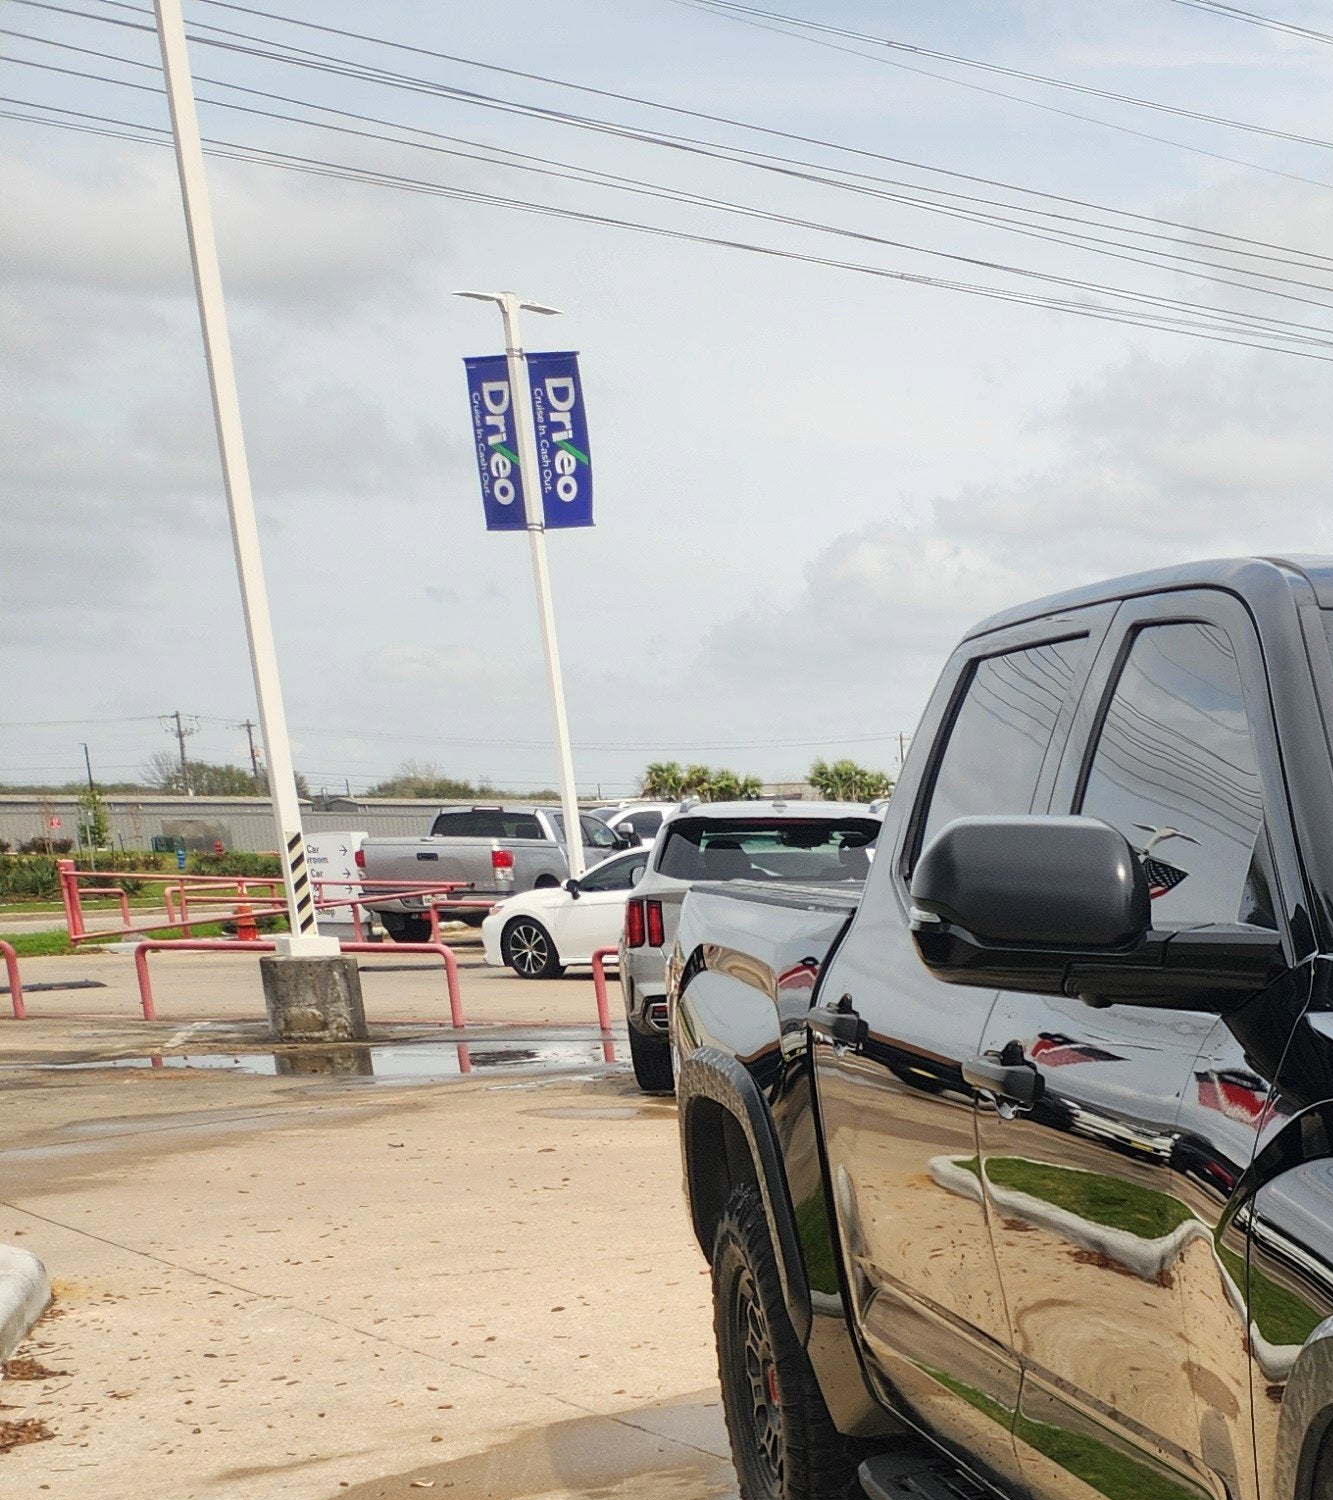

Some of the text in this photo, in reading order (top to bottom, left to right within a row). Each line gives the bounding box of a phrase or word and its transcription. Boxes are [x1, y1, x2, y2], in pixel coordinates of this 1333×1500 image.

[472, 392, 482, 426] Cruise
[477, 443, 488, 471] Cash
[533, 387, 545, 423] Cruise
[539, 439, 552, 467] Cash
[306, 844, 320, 854] Car
